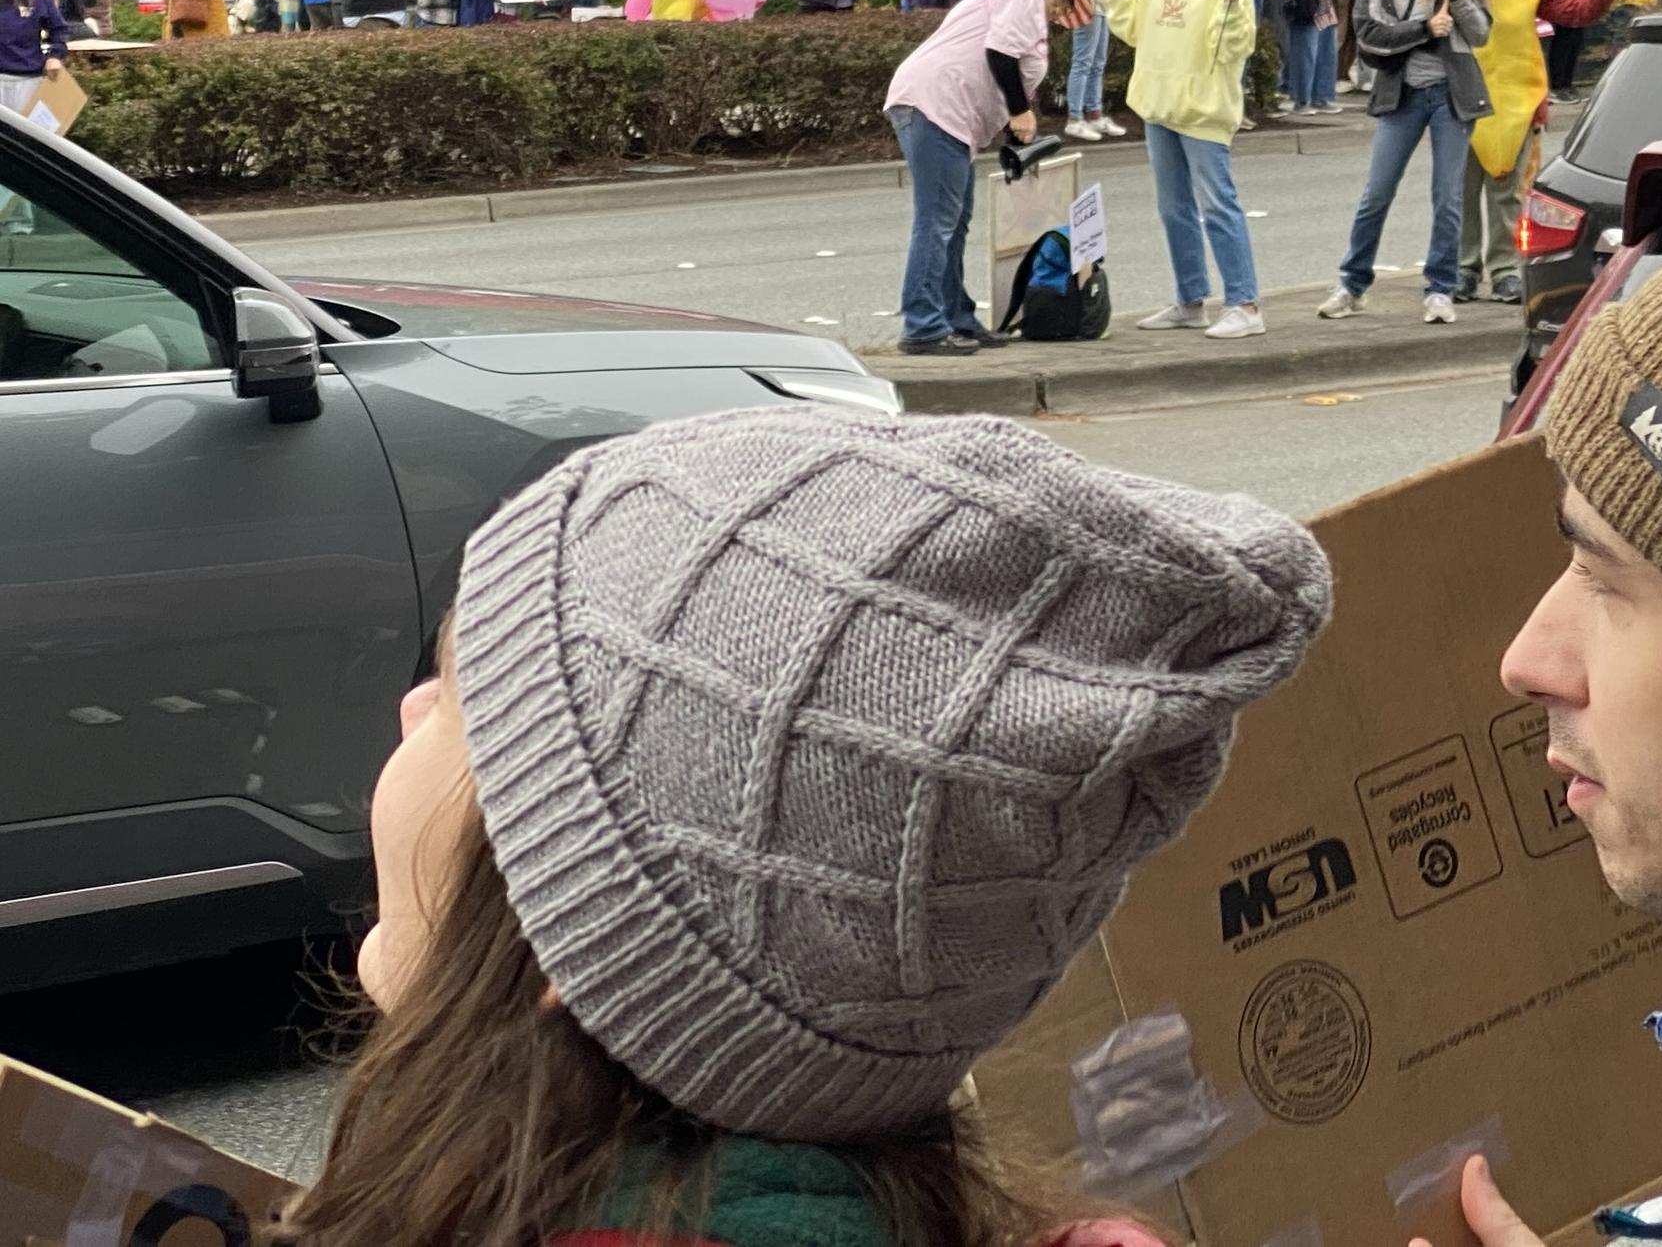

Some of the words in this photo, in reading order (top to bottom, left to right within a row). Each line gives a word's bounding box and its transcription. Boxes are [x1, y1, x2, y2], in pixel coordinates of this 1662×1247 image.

[1388, 783, 1458, 827] Recycles
[1270, 826, 1317, 856] UNION
[1387, 800, 1474, 856] Corrugated
[1230, 848, 1268, 874] LABEL
[1218, 842, 1357, 945] USW
[1317, 890, 1357, 915] UNITED
[1232, 909, 1315, 955] STEELWORKERS
